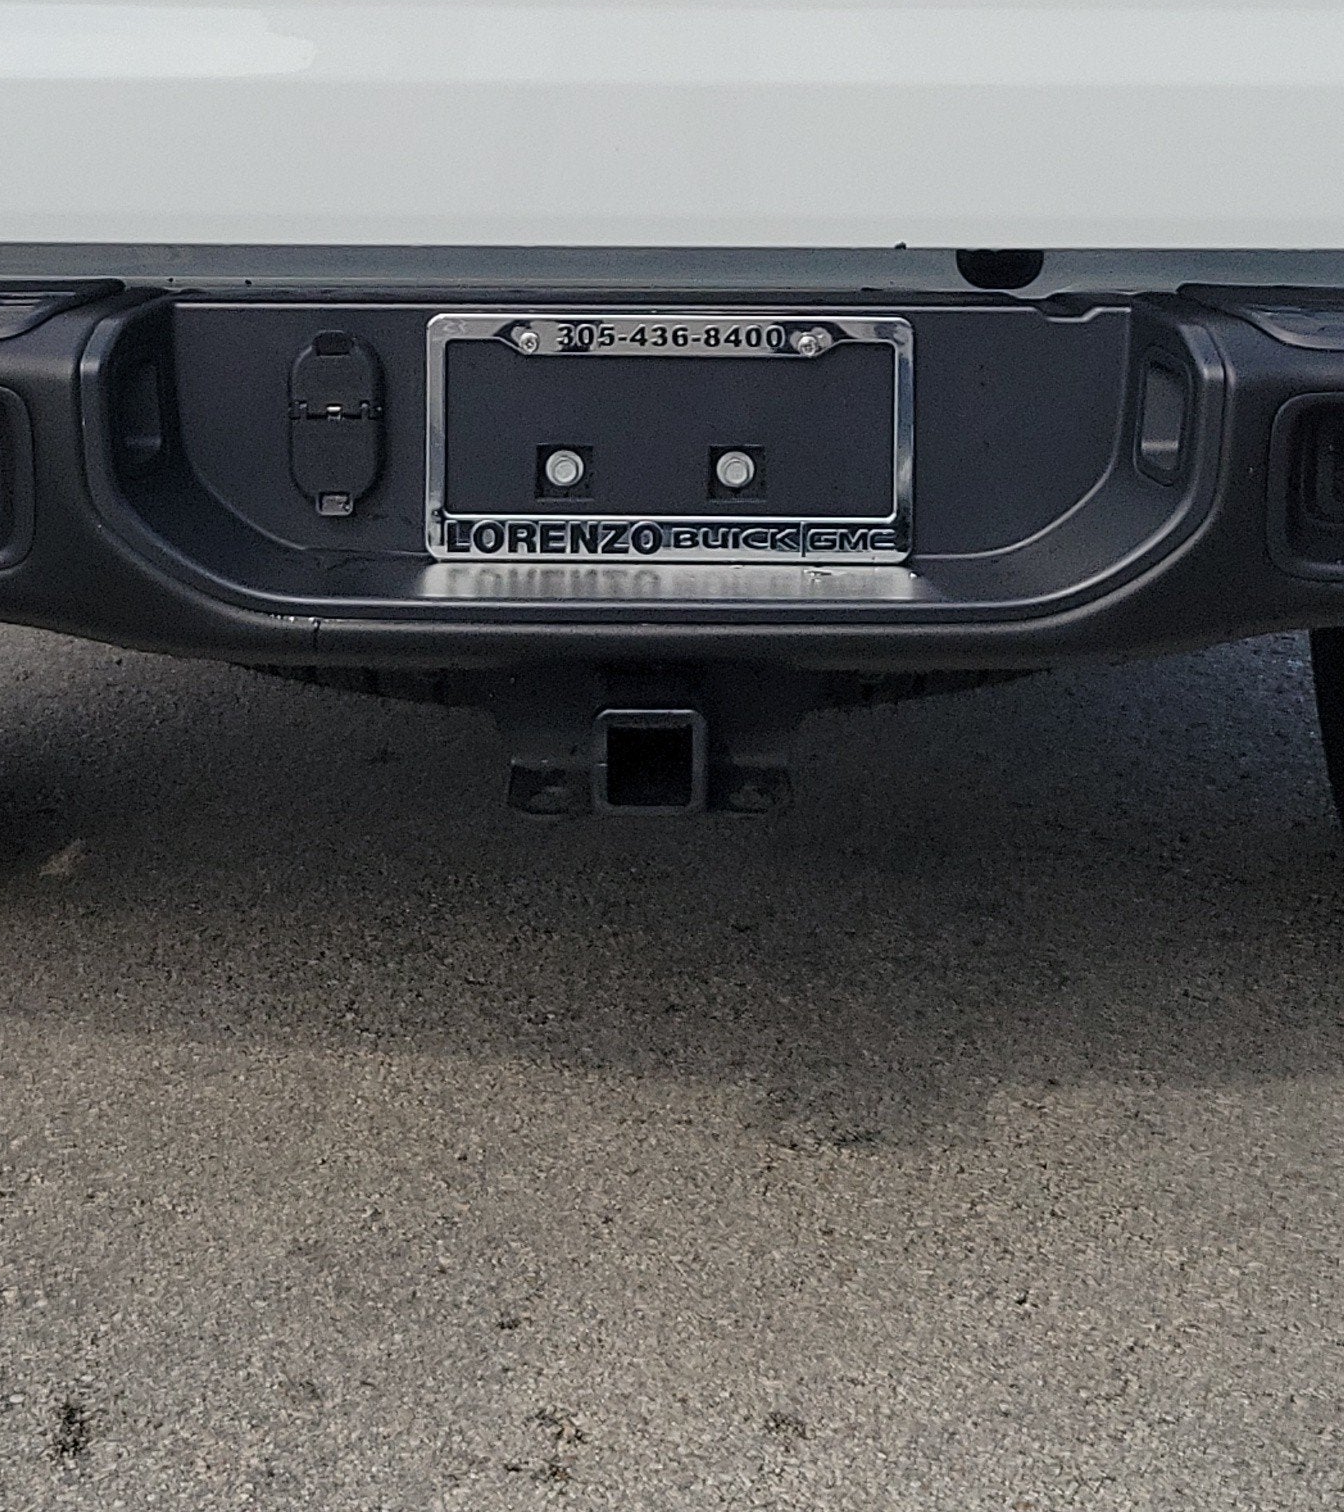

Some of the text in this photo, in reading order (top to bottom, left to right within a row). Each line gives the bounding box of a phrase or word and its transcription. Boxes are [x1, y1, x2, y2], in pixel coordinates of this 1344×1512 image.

[556, 324, 785, 349] 305-436-8400
[446, 519, 898, 555] LORENZO BUICK GMC
